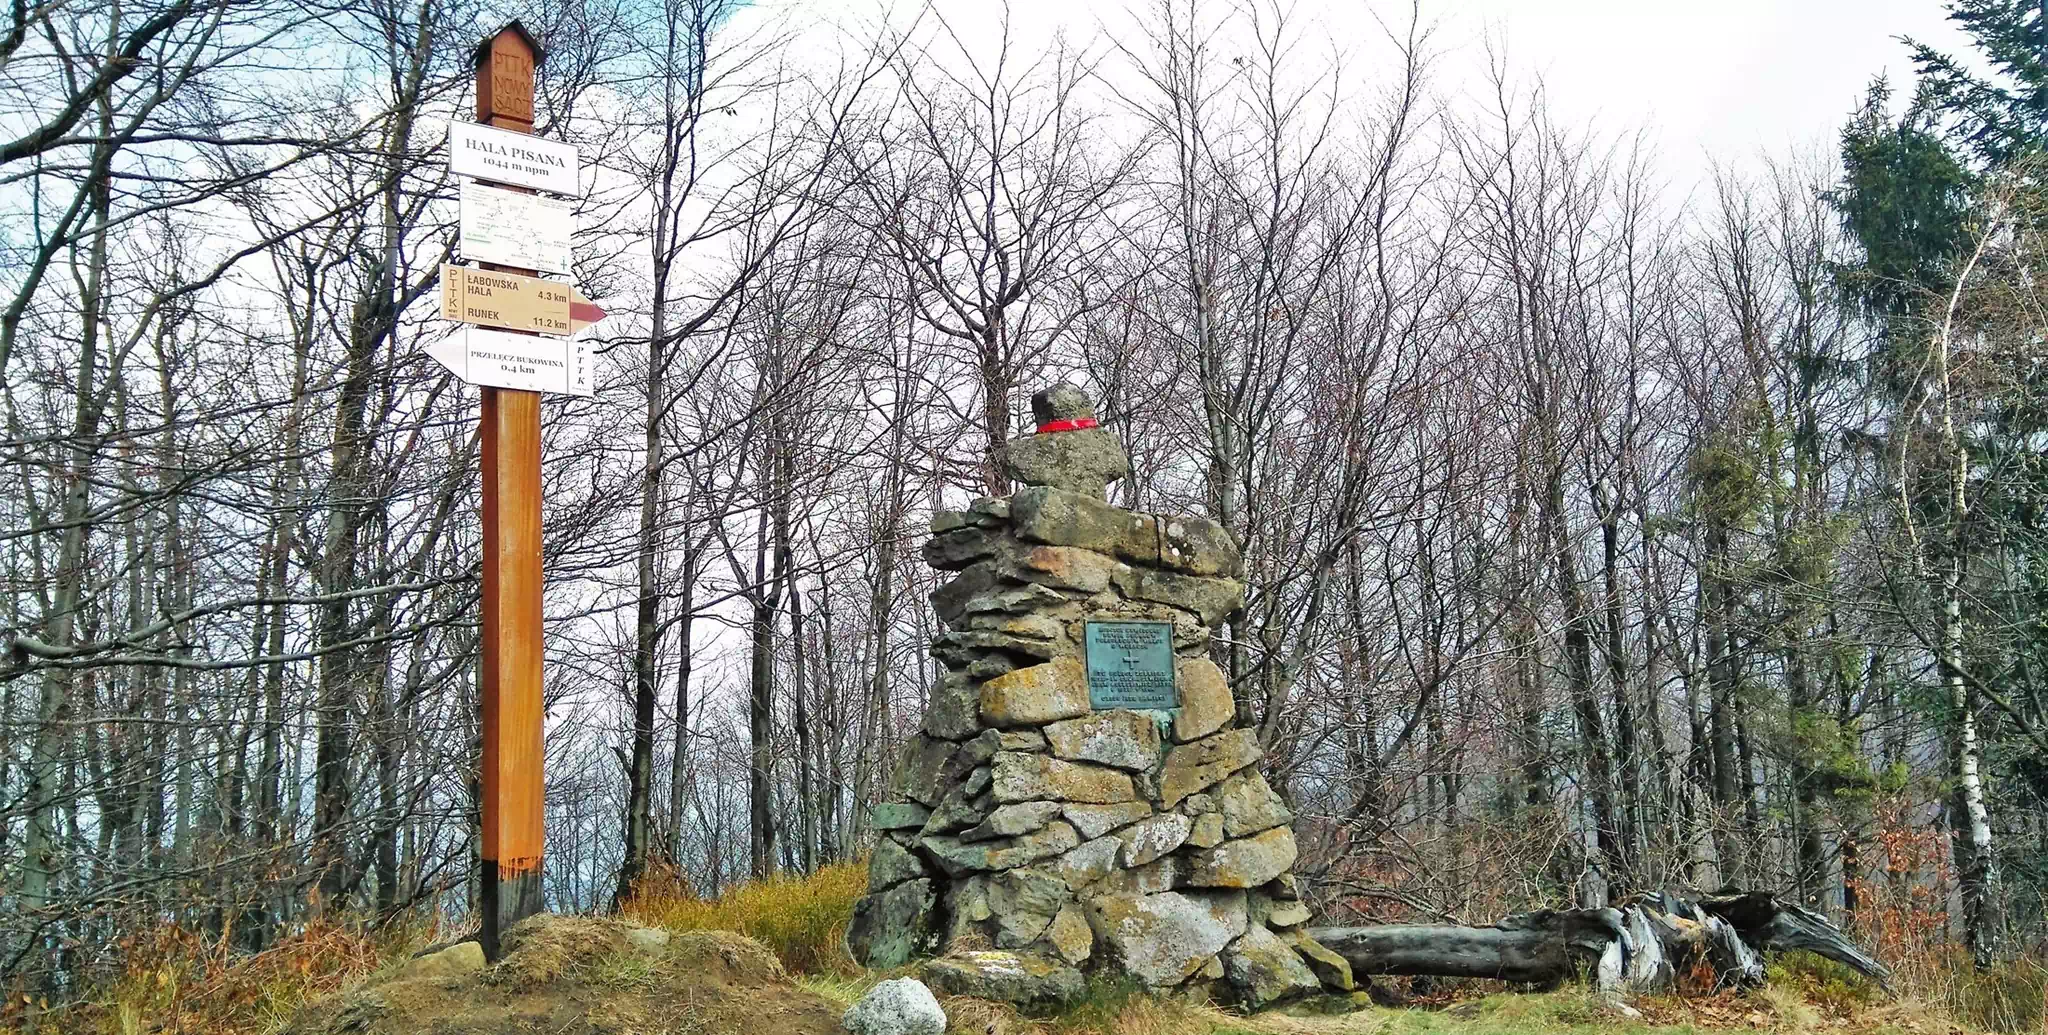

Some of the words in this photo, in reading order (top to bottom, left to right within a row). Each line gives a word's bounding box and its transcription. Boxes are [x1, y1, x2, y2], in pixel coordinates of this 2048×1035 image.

[494, 50, 531, 78] PTTK
[494, 75, 531, 98] NOWY
[465, 138, 507, 156] HALA
[511, 147, 566, 168] PISANA
[483, 157, 509, 170] 1044
[512, 163, 522, 171] m
[525, 165, 549, 176] npm
[449, 269, 457, 308] PTTK
[467, 274, 519, 291] ŁABOWSKA
[467, 285, 492, 297] HALA
[537, 291, 552, 301] 4.3
[554, 292, 567, 303] km
[467, 307, 500, 320] RUNEK
[533, 317, 552, 328] 11.2
[555, 319, 567, 330] km
[500, 364, 517, 374] 0.4
[519, 364, 535, 375] km
[516, 355, 564, 368] BUKOWINA
[577, 346, 586, 385] PTTK
